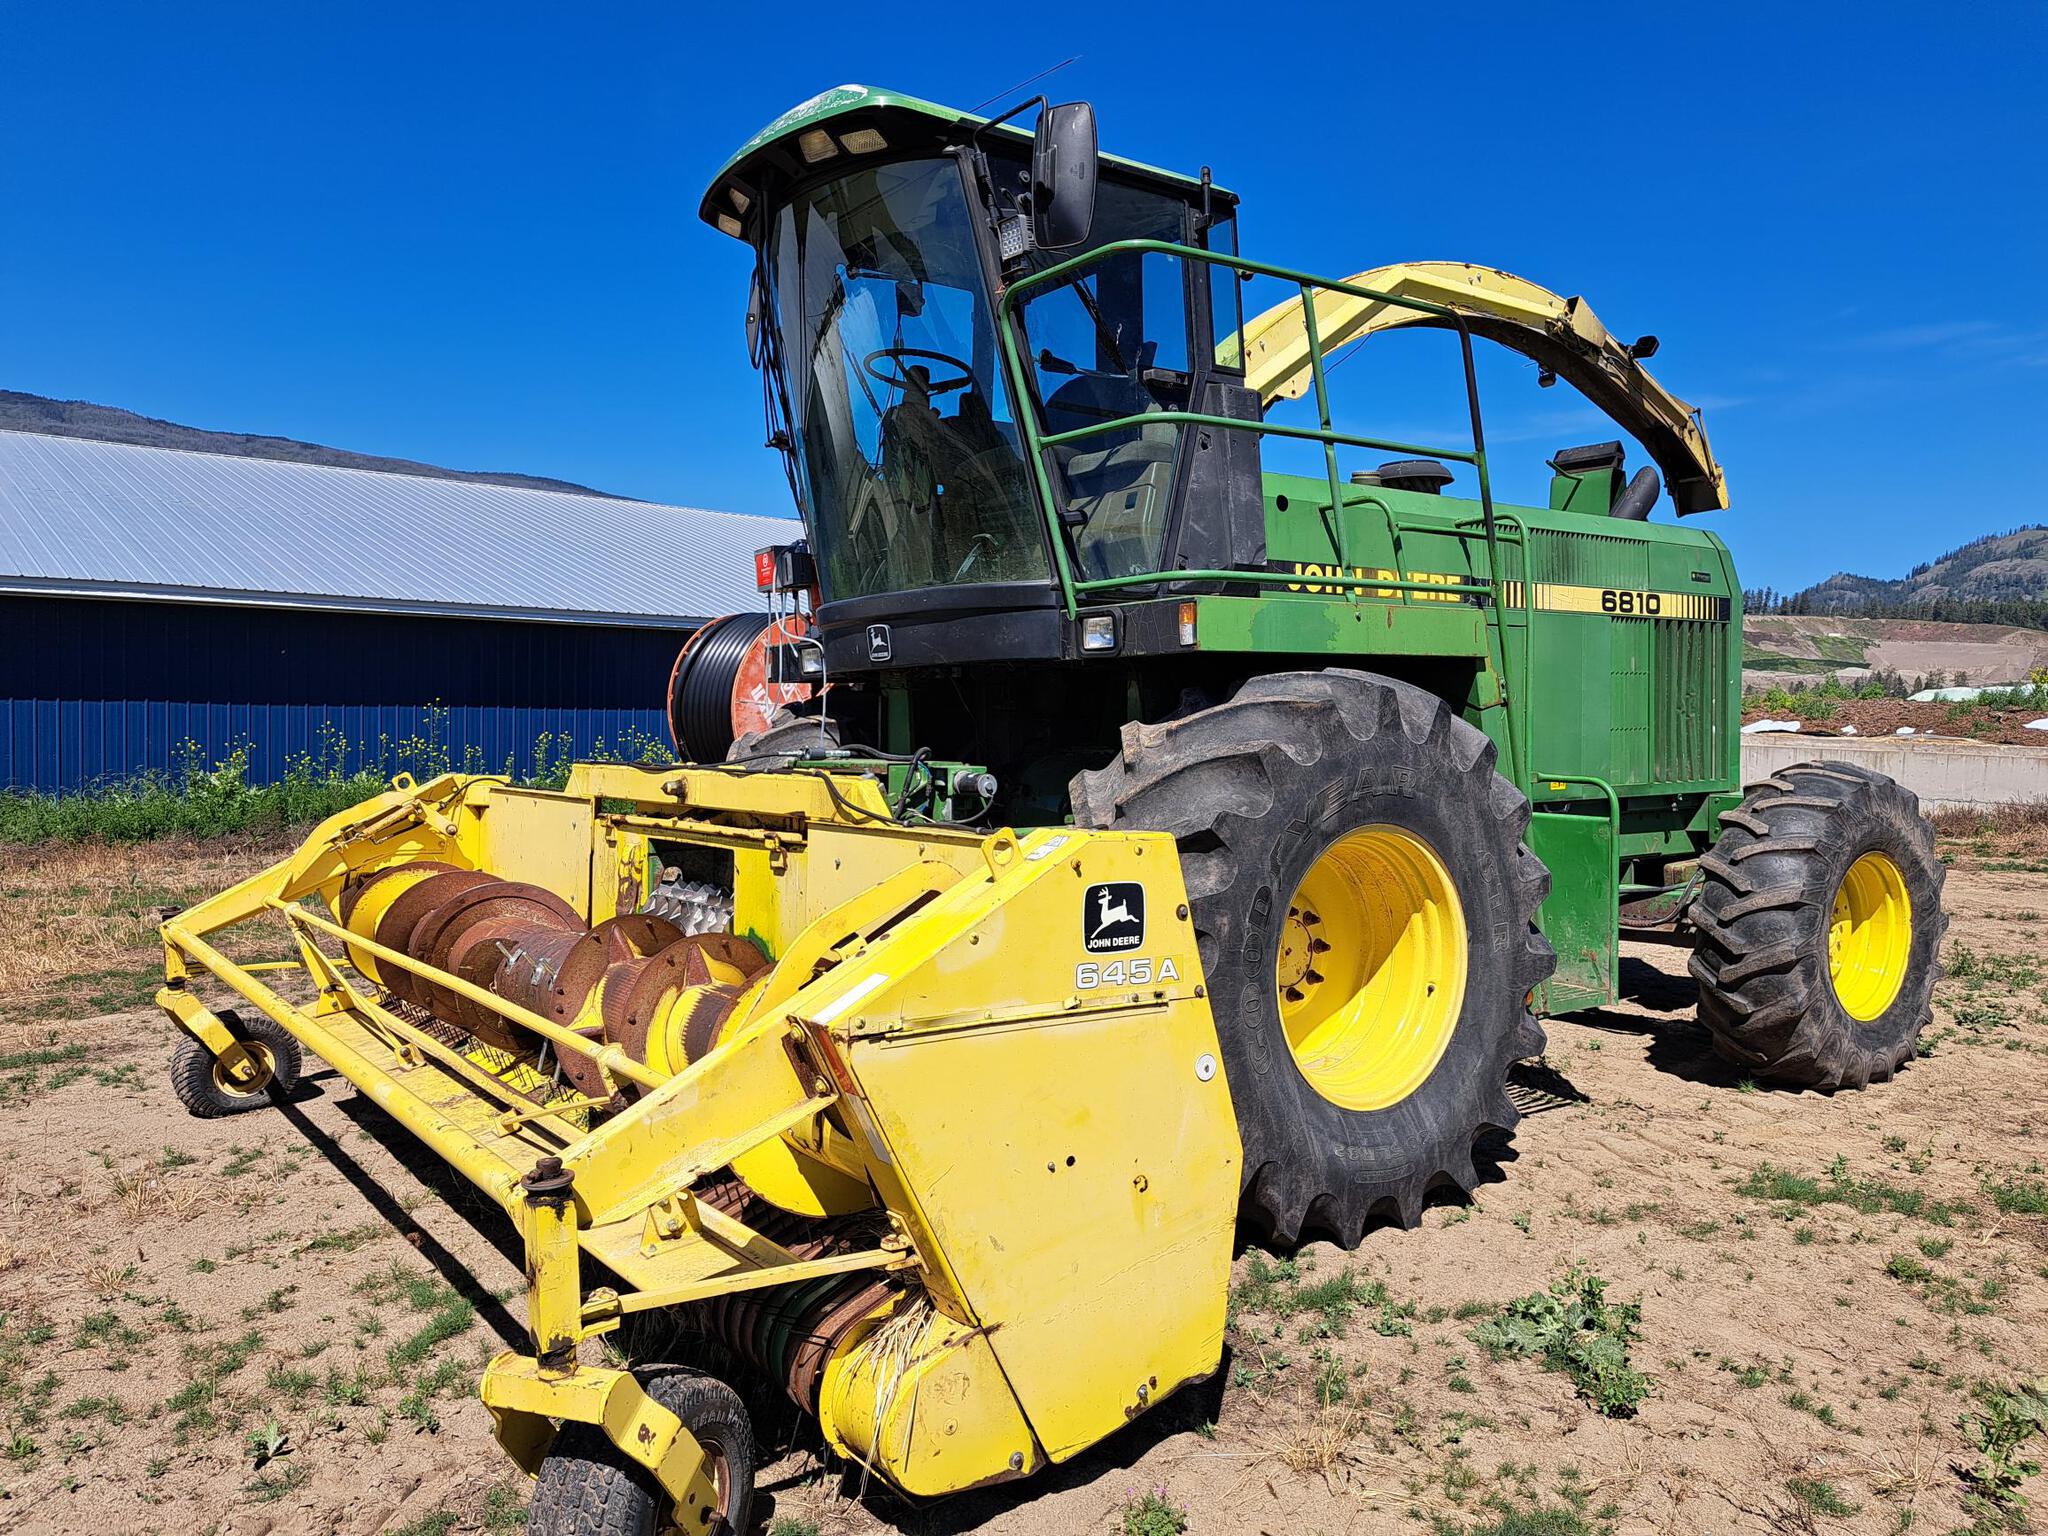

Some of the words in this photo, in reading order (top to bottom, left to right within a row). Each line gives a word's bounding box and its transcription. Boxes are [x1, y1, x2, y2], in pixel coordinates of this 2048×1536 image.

[1602, 590, 1661, 614] 6810
[1240, 765, 1417, 1077] GOODYEAR
[1087, 937, 1111, 949] JOHN
[1112, 935, 1140, 948] DEERE
[1075, 957, 1180, 989] 645A
